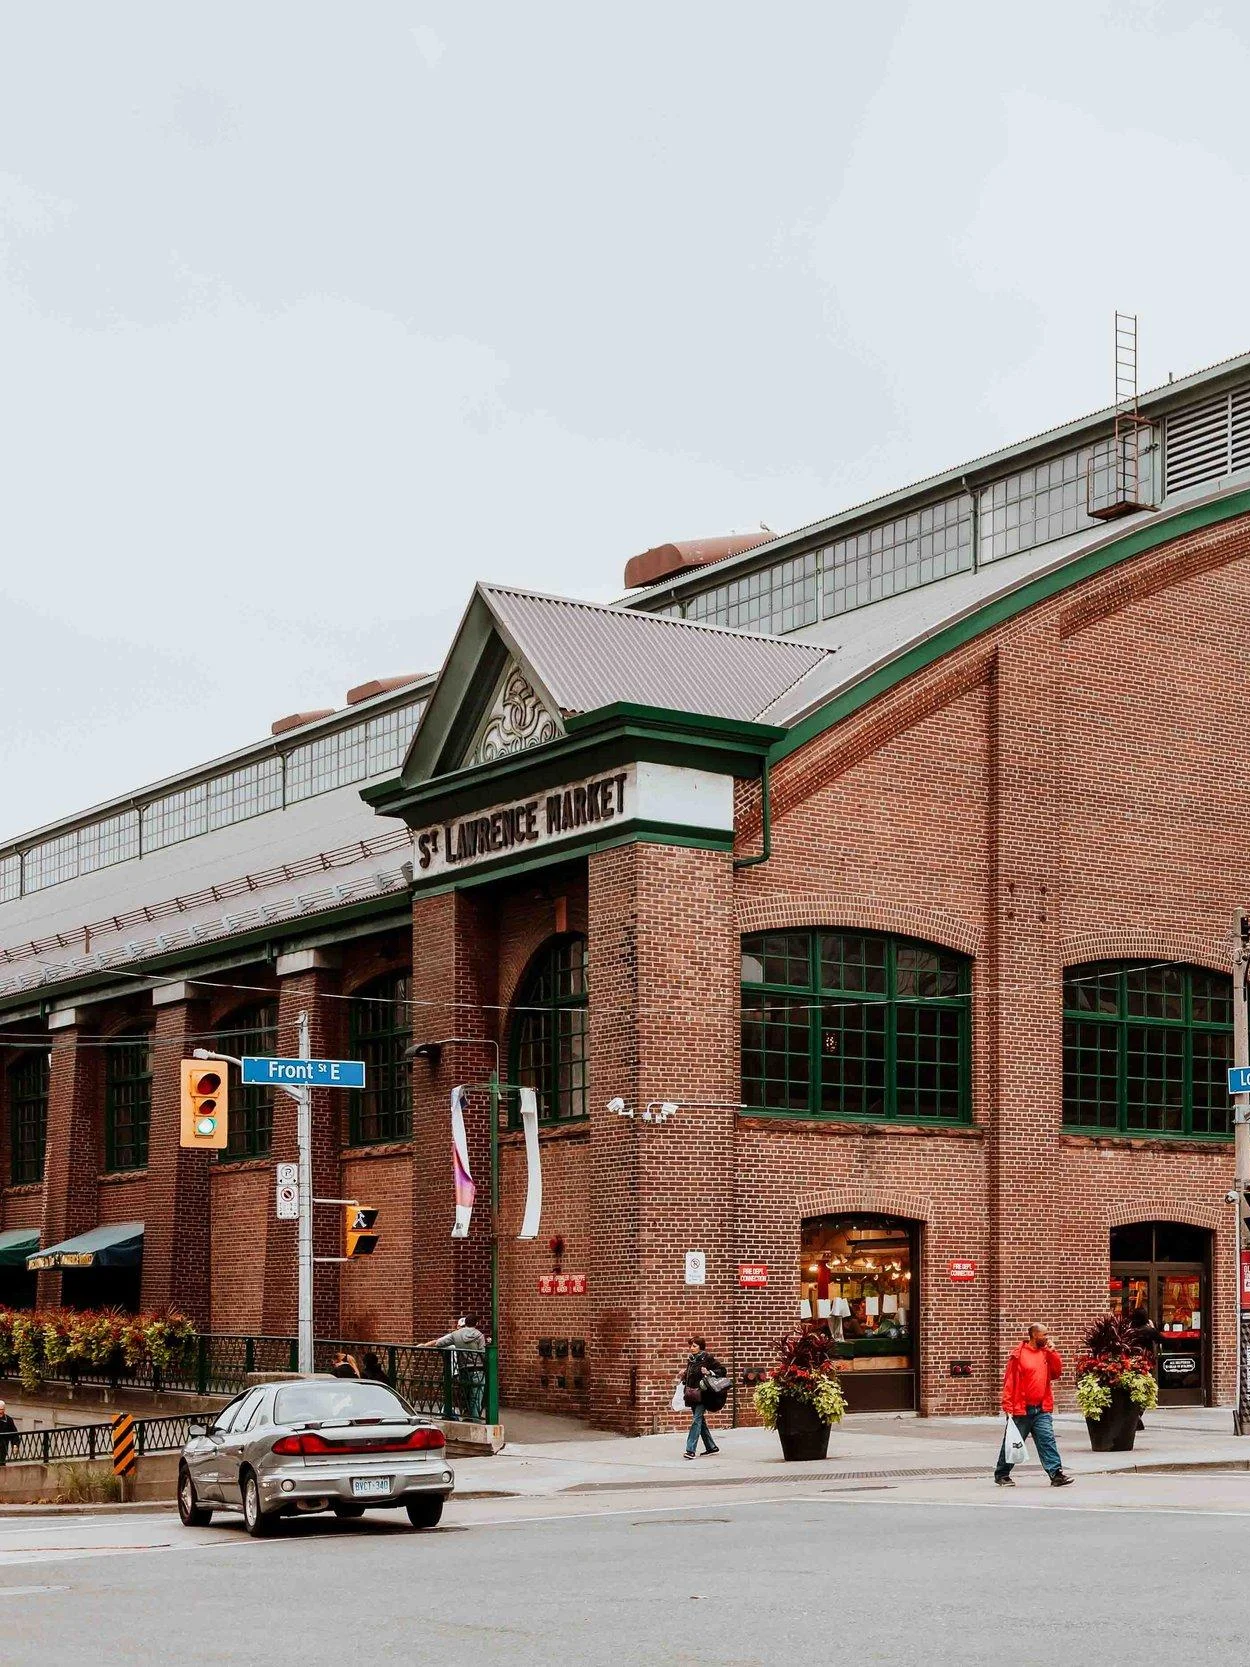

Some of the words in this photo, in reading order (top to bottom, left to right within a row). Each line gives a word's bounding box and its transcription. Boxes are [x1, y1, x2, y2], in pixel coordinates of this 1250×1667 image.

[444, 801, 539, 863] LAWRENCE
[546, 773, 628, 834] MARKET
[269, 1061, 314, 1079] Front
[318, 1063, 328, 1073] St
[330, 1064, 341, 1080] E
